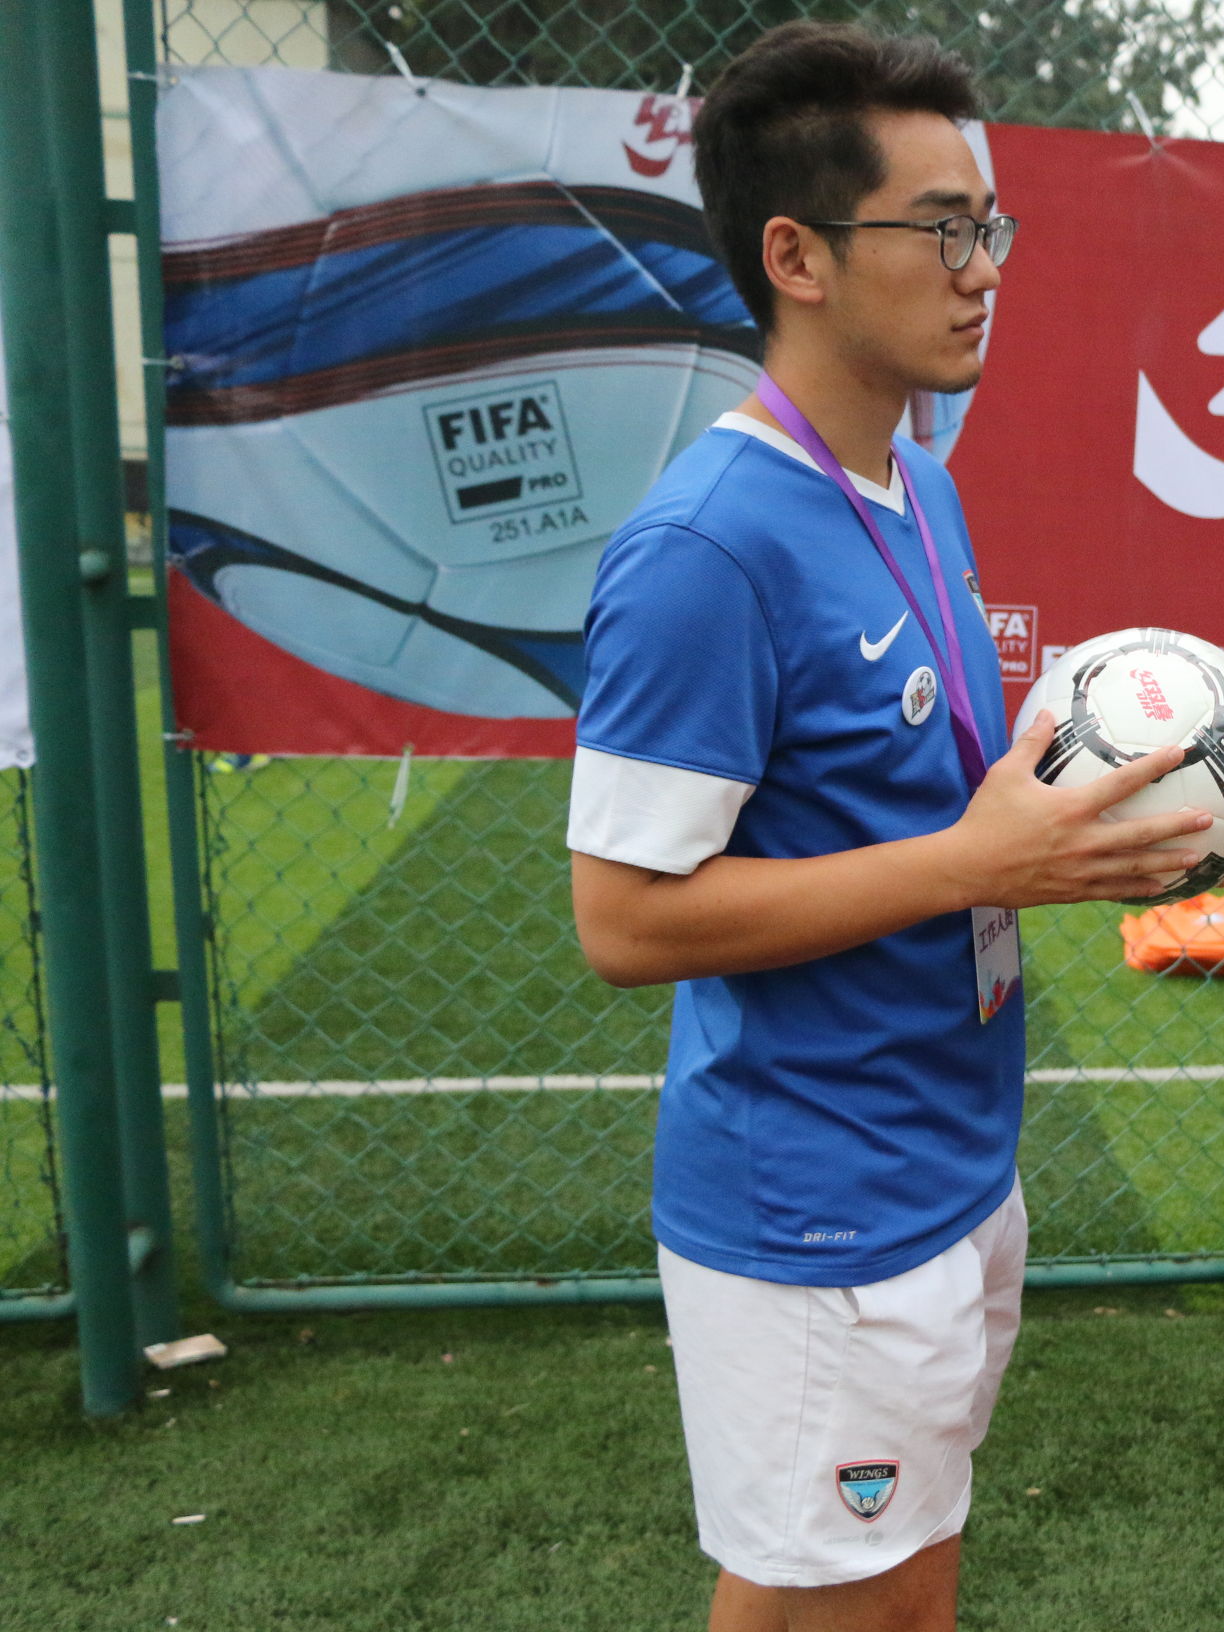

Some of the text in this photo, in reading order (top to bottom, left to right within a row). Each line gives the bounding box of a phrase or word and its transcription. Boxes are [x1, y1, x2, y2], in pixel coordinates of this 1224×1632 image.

[438, 395, 554, 451] FIFA
[447, 438, 558, 478] QUALITY
[528, 472, 568, 492] PRO
[490, 505, 589, 543] 251.A1A
[987, 612, 1029, 638] FA
[1002, 660, 1029, 673] PRO
[802, 1230, 857, 1243] DRI-FIT
[847, 1467, 889, 1480] WINGS
